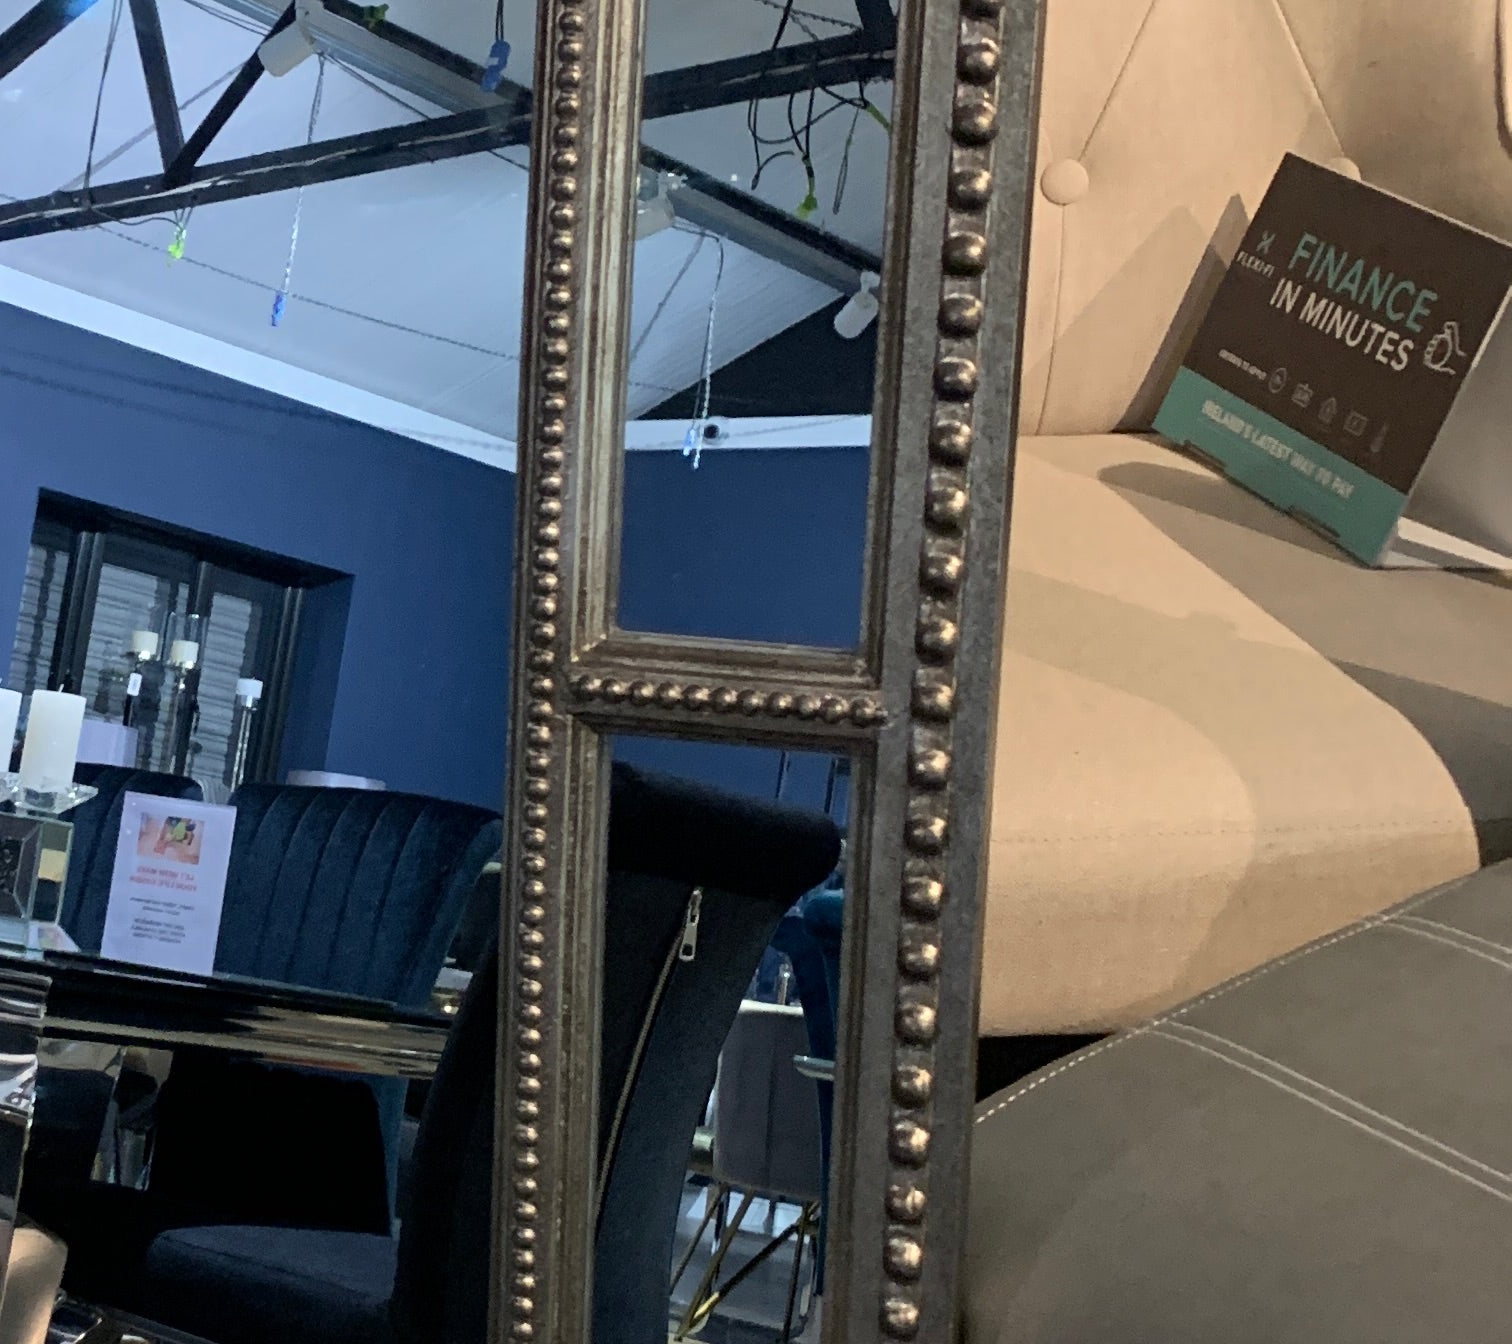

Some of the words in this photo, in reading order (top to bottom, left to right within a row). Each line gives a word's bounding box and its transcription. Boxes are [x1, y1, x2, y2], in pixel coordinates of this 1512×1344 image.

[1269, 277, 1303, 313] IN
[1299, 292, 1415, 371] MINUTES
[1290, 231, 1438, 333] FINANCE
